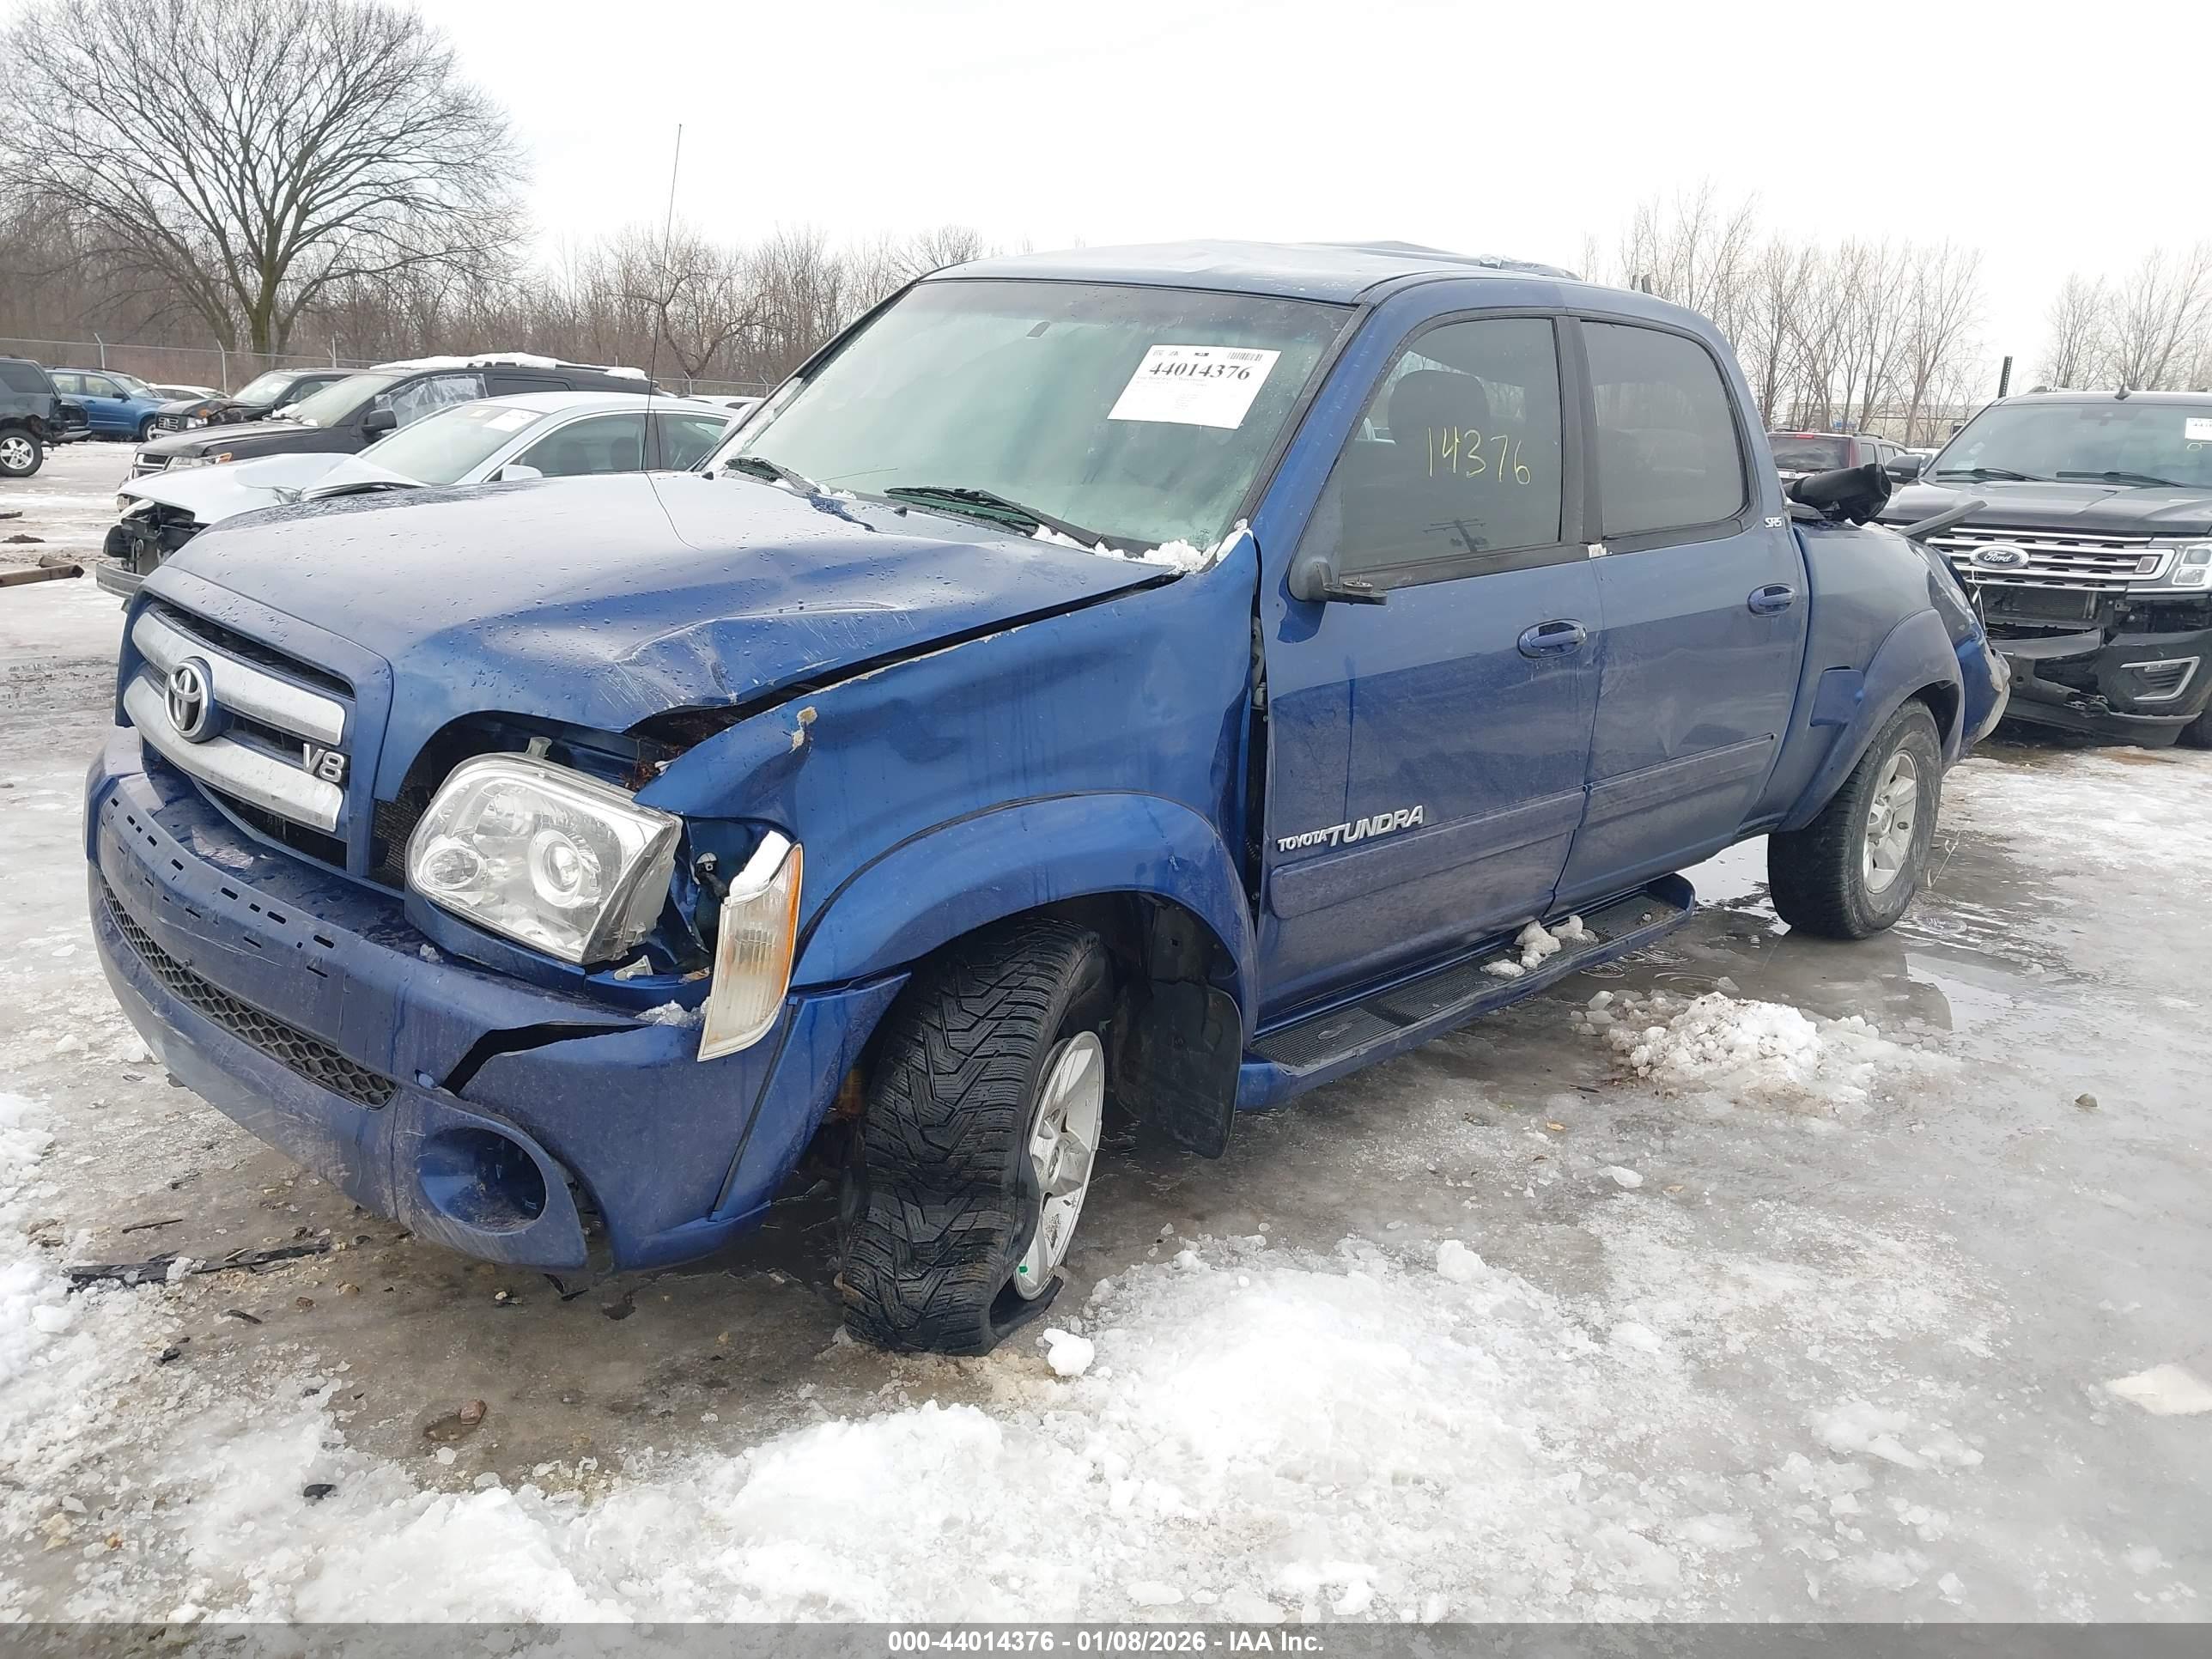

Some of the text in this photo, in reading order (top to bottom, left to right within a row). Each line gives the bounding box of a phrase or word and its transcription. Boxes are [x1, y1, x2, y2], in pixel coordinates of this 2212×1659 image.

[1149, 362, 1254, 381] 44014376
[1428, 426, 1531, 485] 14376
[1984, 550, 2014, 562] Ford
[303, 743, 345, 783] V8
[1277, 805, 1425, 853] TOYOTA TUNDRA
